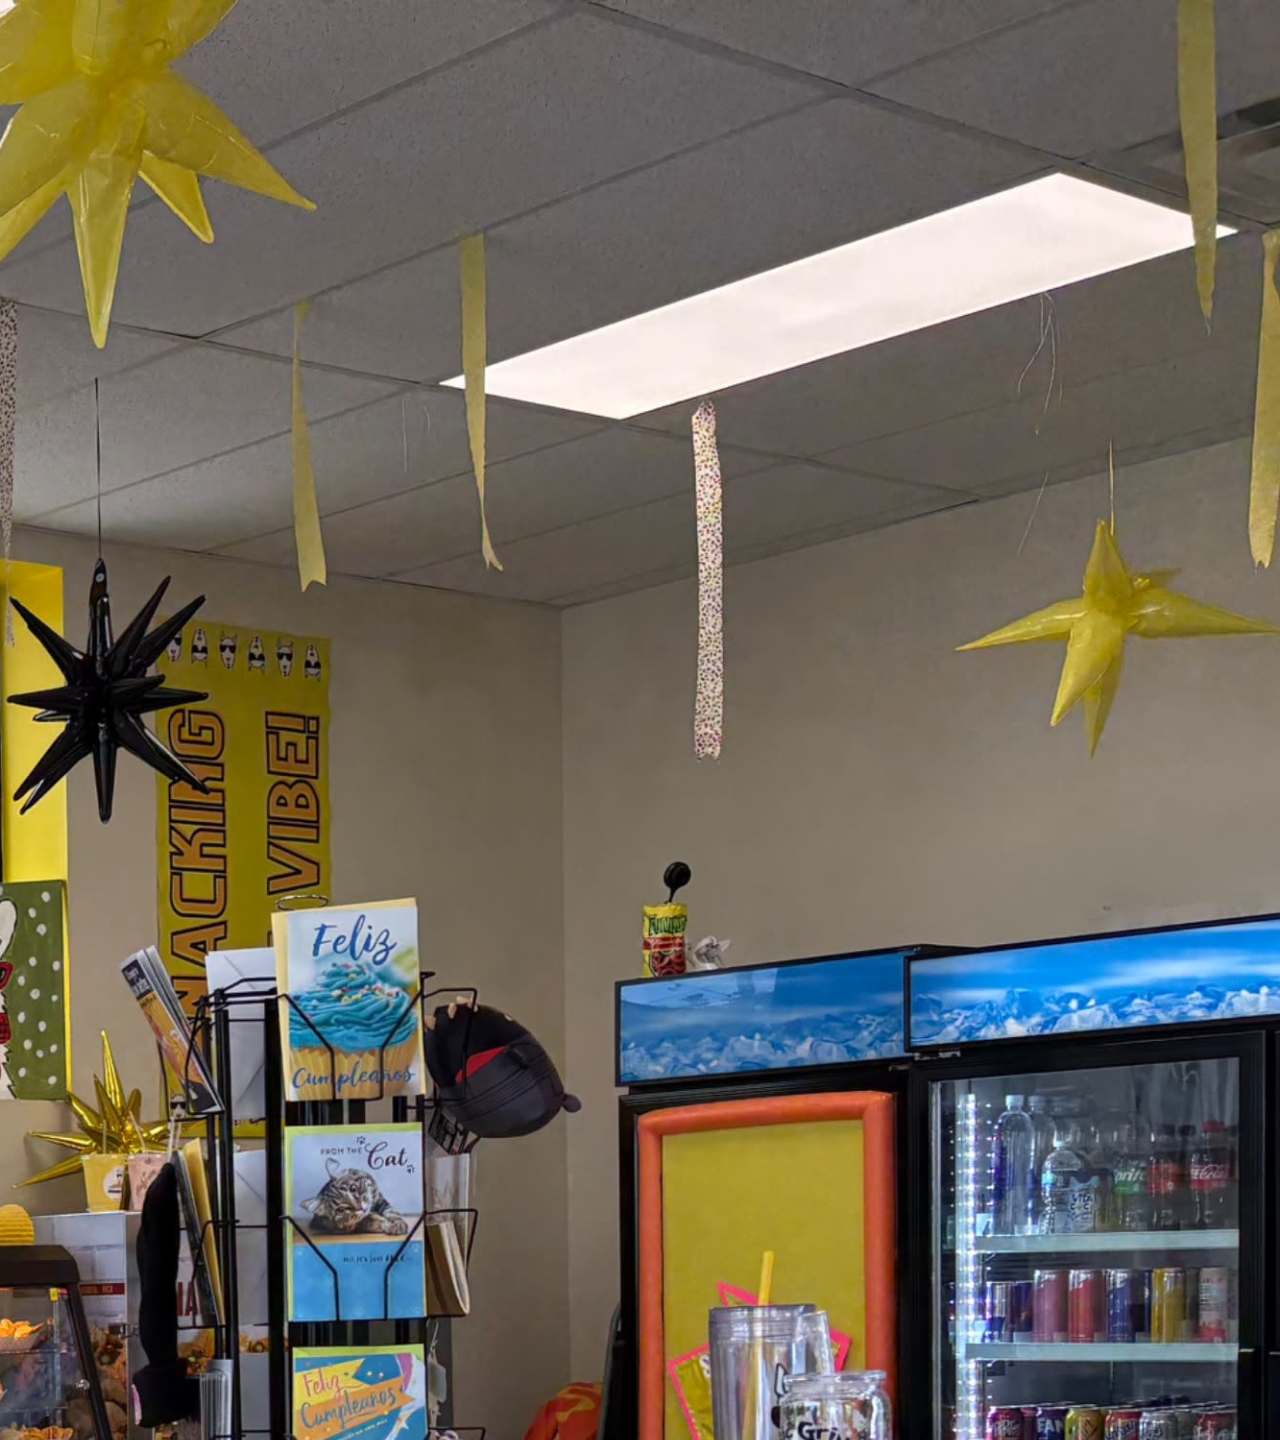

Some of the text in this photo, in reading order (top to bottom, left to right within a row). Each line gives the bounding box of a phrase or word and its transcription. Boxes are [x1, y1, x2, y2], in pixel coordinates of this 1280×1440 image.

[265, 711, 320, 896] VIBE!
[313, 914, 398, 967] Feliz
[364, 1139, 410, 1170] Cat
[303, 1371, 345, 1398] Feliz
